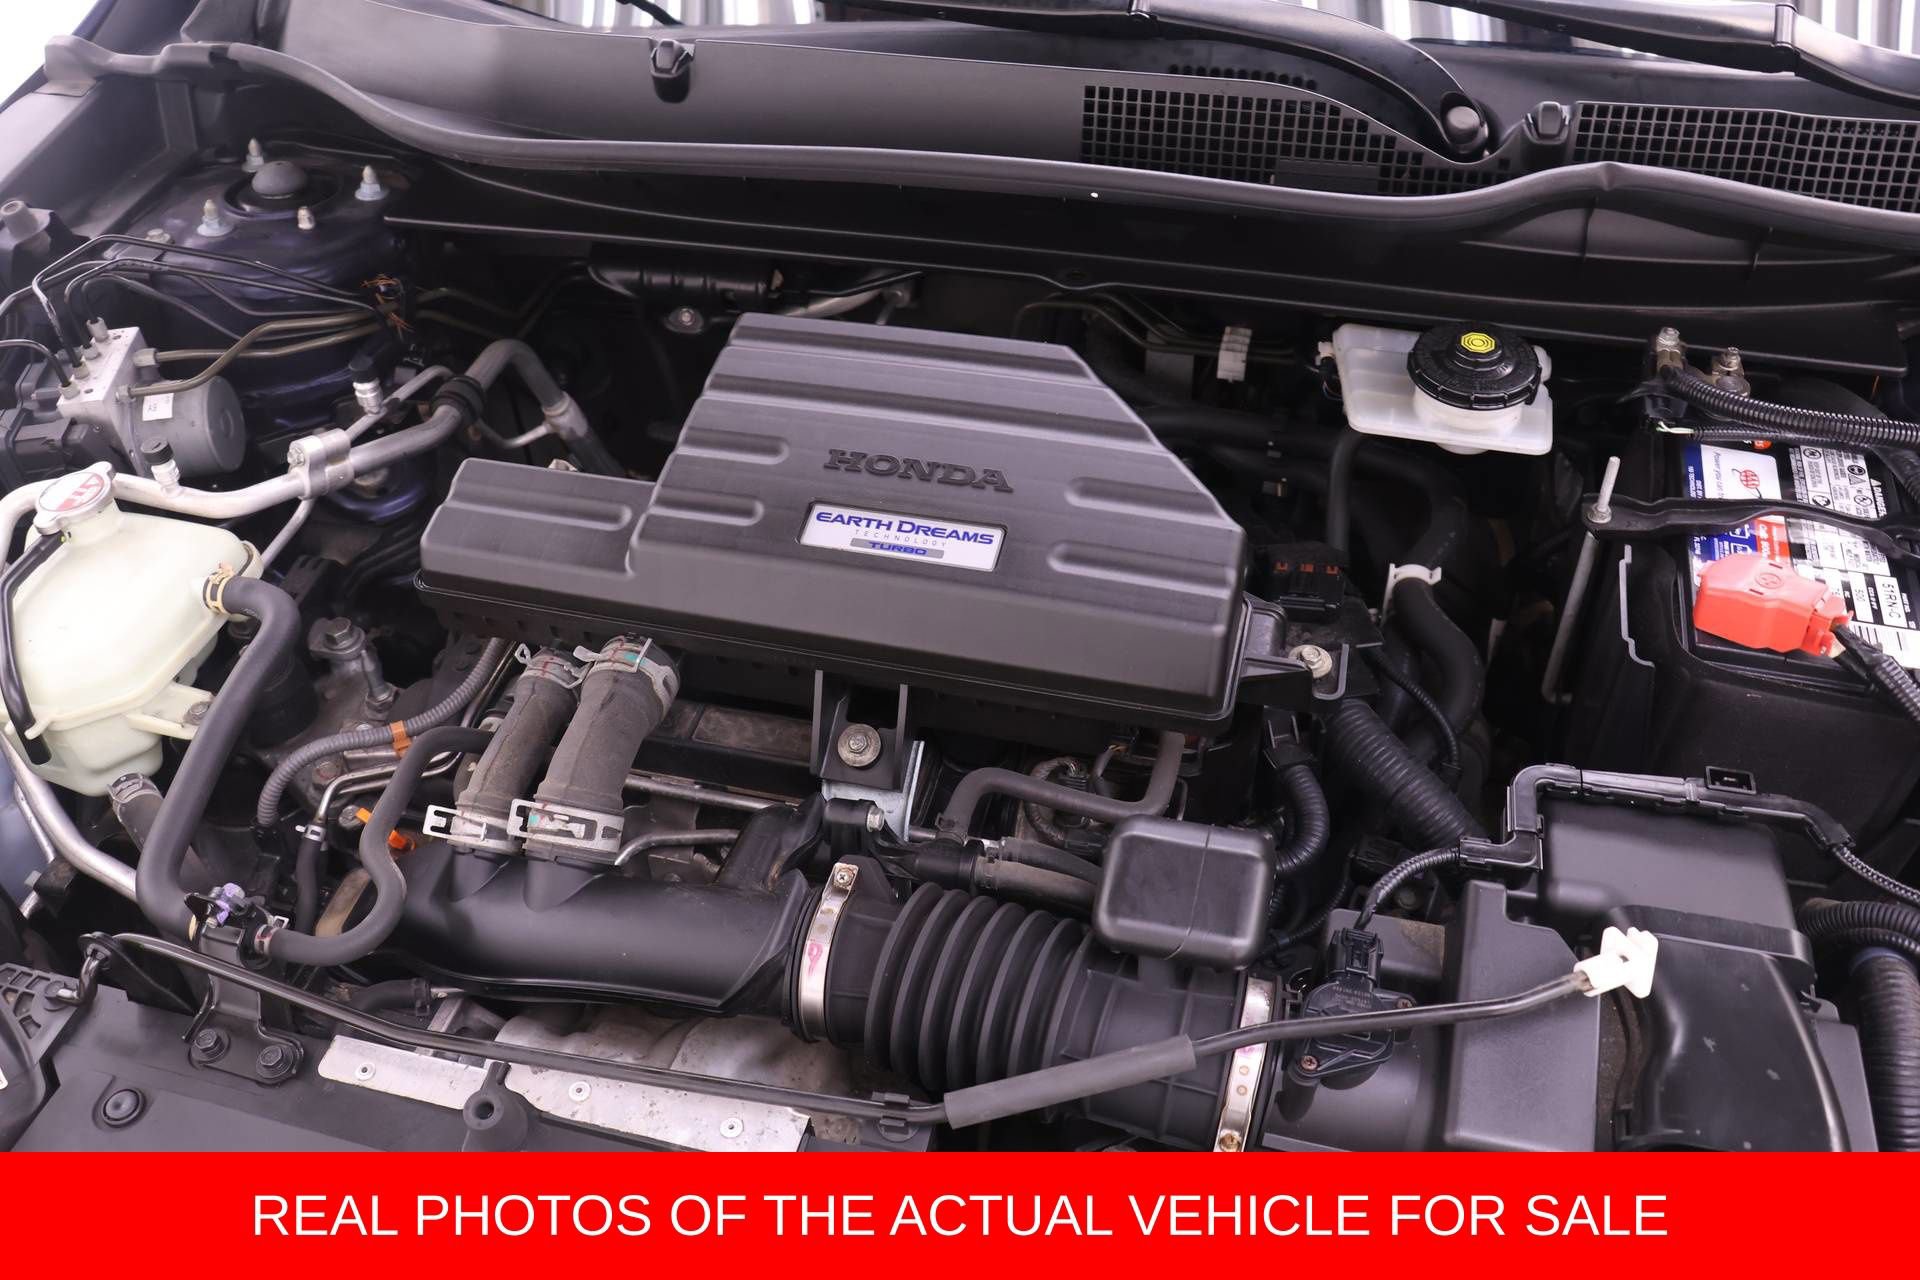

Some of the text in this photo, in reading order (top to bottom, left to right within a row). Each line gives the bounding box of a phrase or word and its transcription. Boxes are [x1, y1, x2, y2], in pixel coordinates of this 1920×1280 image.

[823, 448, 1014, 493] HONDA
[815, 511, 995, 545] EARTH DREAMS
[854, 529, 948, 547] TECHNOLOGY
[868, 541, 928, 556] TURBO
